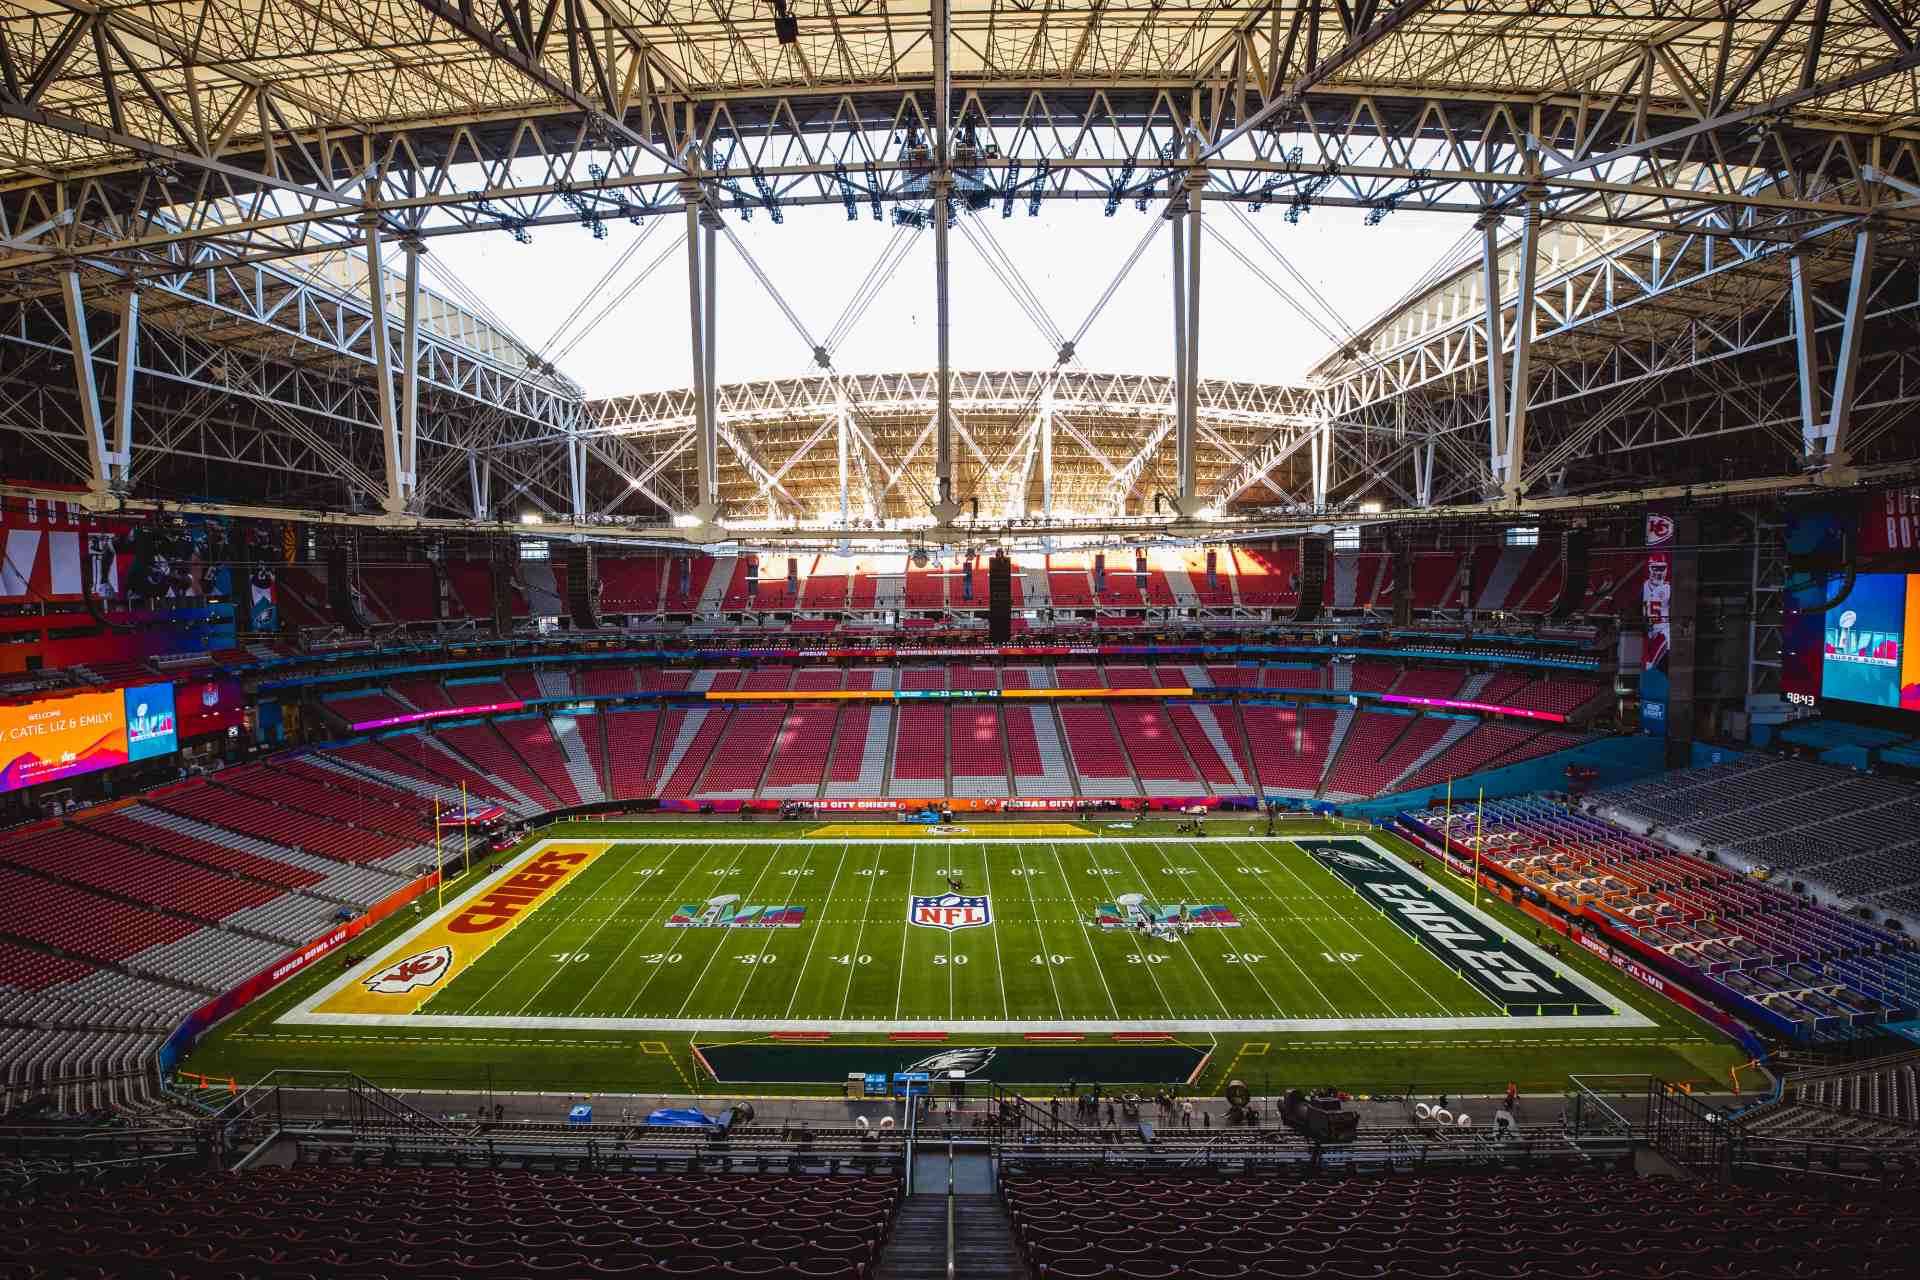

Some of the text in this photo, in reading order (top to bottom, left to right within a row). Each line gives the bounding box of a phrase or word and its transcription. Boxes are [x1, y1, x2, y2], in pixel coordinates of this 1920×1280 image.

[1830, 654, 1891, 666] SUPER BOWL
[1787, 692, 1815, 706] 98:43
[50, 719, 66, 732] LIZ
[831, 801, 855, 809] CITY
[858, 801, 896, 809] CHIEFS
[1049, 800, 1074, 808] CITY
[448, 850, 589, 934] CHIEFS
[918, 906, 983, 925] NFL
[1364, 882, 1563, 994] EAGLES
[272, 930, 346, 980] SUPER BOWL LVII
[559, 951, 590, 963] 10
[646, 953, 683, 964] 20
[742, 953, 777, 964] 30
[835, 953, 873, 965] 40
[932, 954, 969, 966] 50
[1030, 953, 1064, 966] 40
[1126, 952, 1161, 965] 30
[1222, 952, 1258, 965] 20
[1320, 951, 1356, 963] 10
[382, 955, 445, 983] KC
[1642, 971, 1664, 991] LVII
